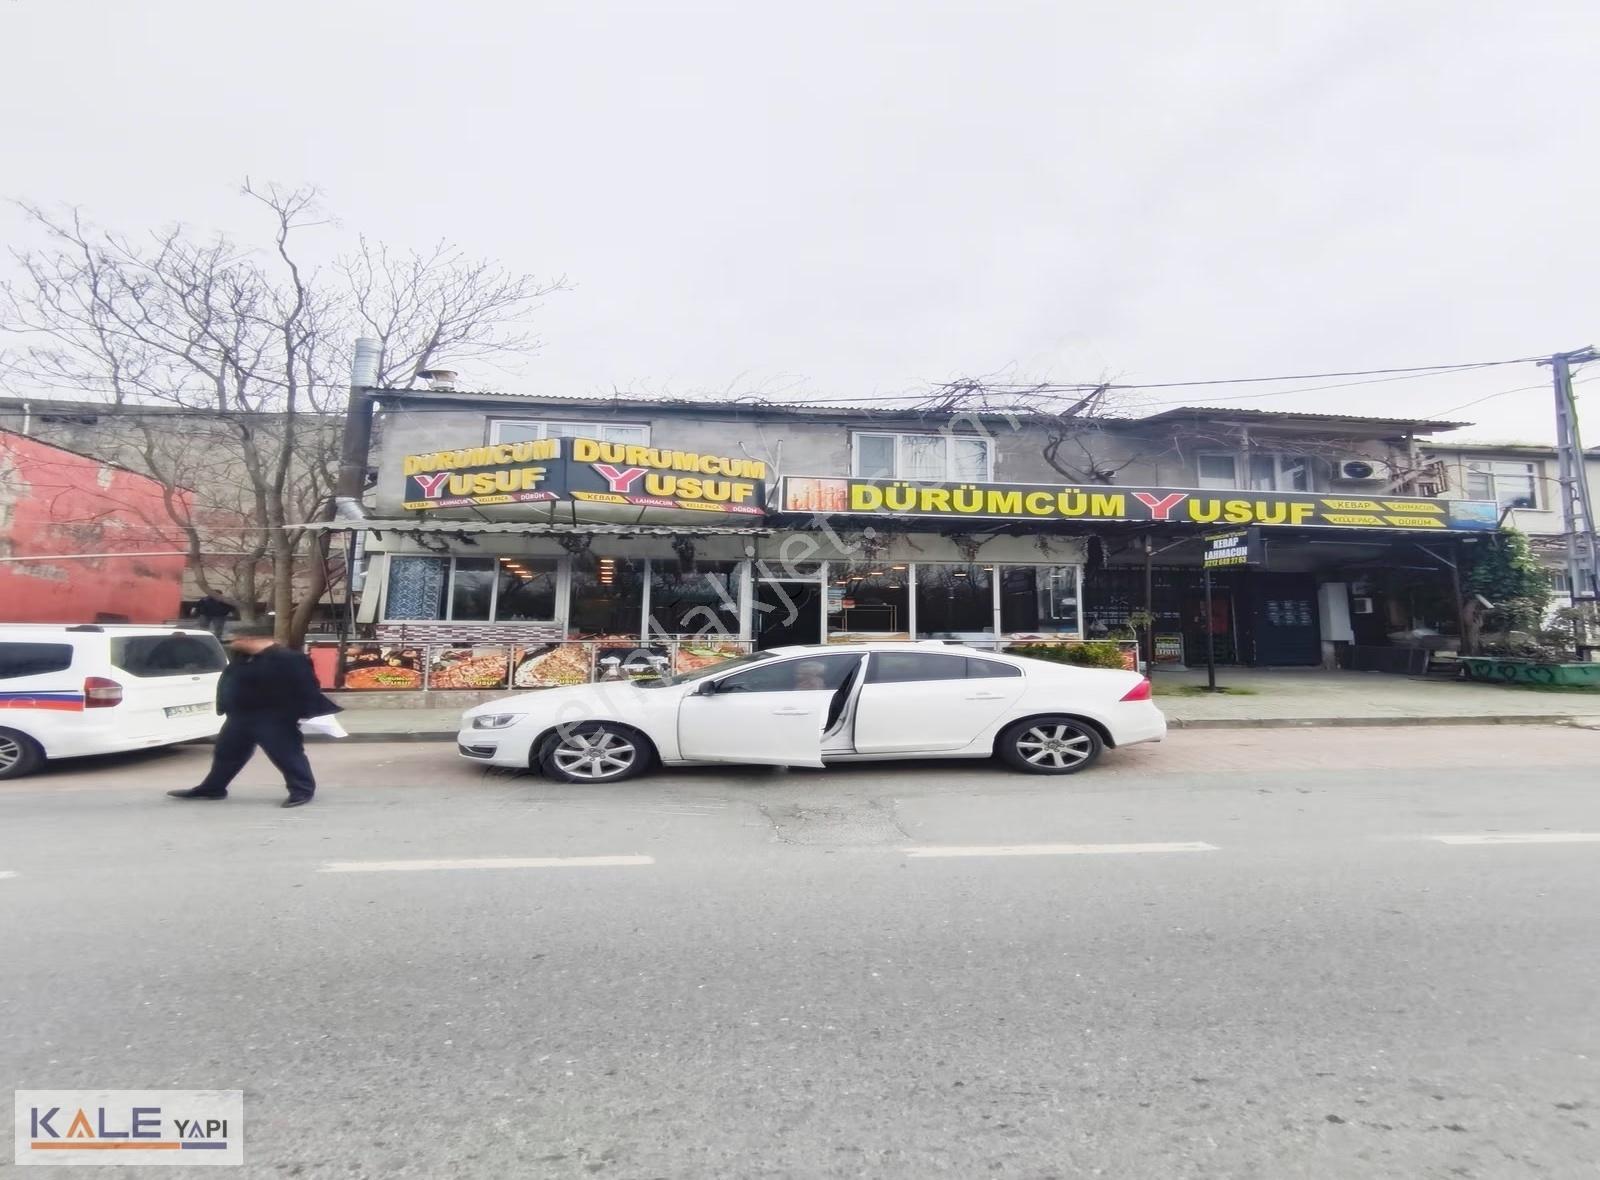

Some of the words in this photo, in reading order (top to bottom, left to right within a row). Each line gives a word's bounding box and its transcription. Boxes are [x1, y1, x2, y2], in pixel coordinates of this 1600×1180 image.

[414, 467, 547, 498] YUSUF
[591, 463, 754, 503] YUSUF
[587, 494, 617, 502] KEBAP
[635, 498, 673, 507] LAHMACUN
[851, 482, 1126, 517] DÜRÜMCÜM
[1131, 492, 1316, 524] YUSUF
[1337, 501, 1371, 509] KEBAP
[1392, 503, 1435, 511] LAHMACUN
[1398, 517, 1431, 526] DÜRÜM
[1213, 537, 1239, 549] KEBAP
[1204, 546, 1248, 560] LAHMACUN
